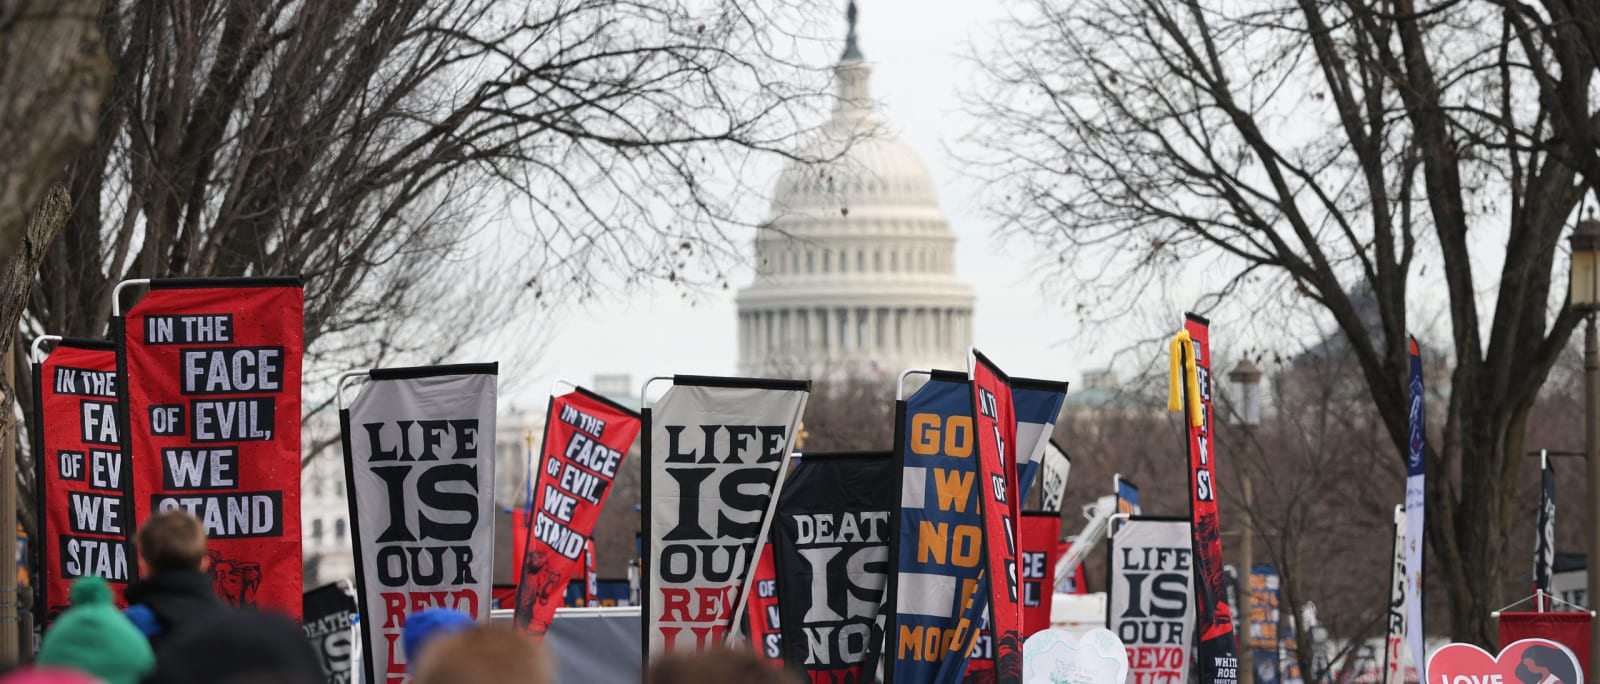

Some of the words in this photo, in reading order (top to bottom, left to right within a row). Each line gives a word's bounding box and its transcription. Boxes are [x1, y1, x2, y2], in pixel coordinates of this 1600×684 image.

[149, 317, 174, 343] IN
[181, 315, 229, 342] THE
[56, 368, 76, 393] IN
[80, 370, 116, 396] THE
[185, 349, 279, 392] FACE
[83, 402, 120, 443] FA
[152, 407, 180, 433] OF
[196, 400, 271, 440] EVIL,
[362, 418, 479, 462] LIFE
[560, 404, 578, 425] IN
[579, 411, 605, 438] THE
[910, 412, 974, 458] GO
[565, 432, 622, 479] FACE
[664, 424, 786, 465] LIFE
[61, 453, 82, 478] OF
[93, 451, 122, 489] EV
[166, 449, 234, 488] WE
[547, 456, 561, 478] OF
[560, 463, 600, 505] EVIL,
[72, 494, 121, 533] WE
[369, 463, 480, 543] IS
[543, 485, 577, 523] WE
[662, 467, 779, 541] IS
[534, 511, 585, 560] STAND
[792, 511, 890, 545] DEAT
[917, 520, 983, 568] NO
[66, 538, 129, 580] STAN
[376, 545, 479, 588] OUR
[1022, 551, 1046, 579] CE
[1121, 547, 1192, 571] LIFE
[797, 545, 888, 623] IS
[1120, 572, 1188, 618] IS
[802, 623, 871, 664] NO
[1118, 620, 1184, 645] OUR
[1126, 646, 1184, 670] REVO
